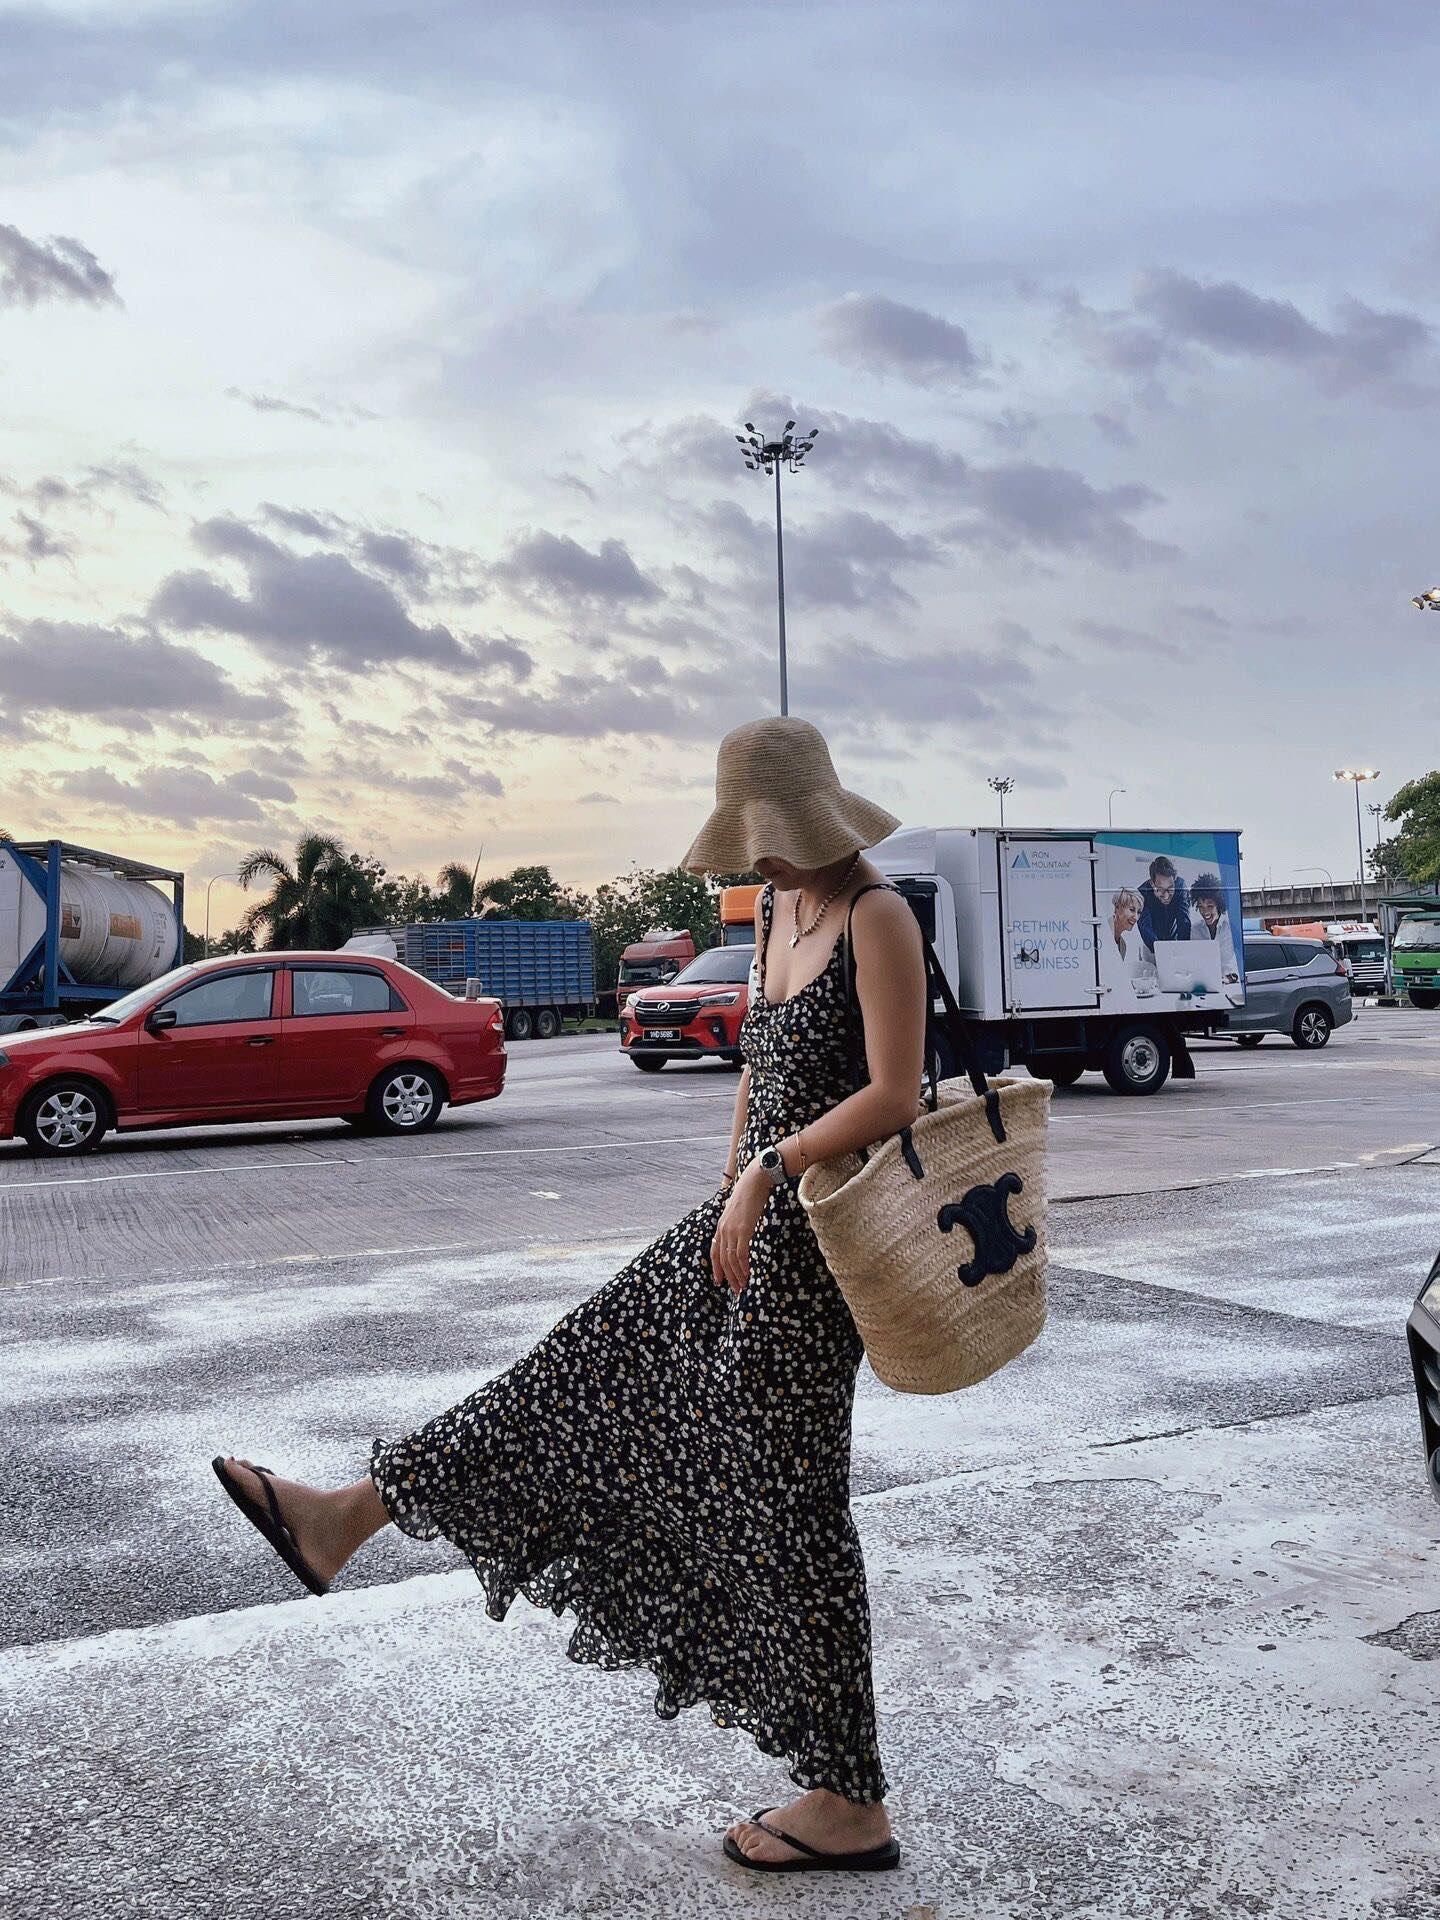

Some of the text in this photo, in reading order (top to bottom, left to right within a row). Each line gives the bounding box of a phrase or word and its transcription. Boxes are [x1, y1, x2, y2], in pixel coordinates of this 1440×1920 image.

[1032, 861, 1070, 869] MOUNTAIN
[1012, 920, 1070, 933] RETHINK
[1013, 938, 1103, 952] HOW YOU DO
